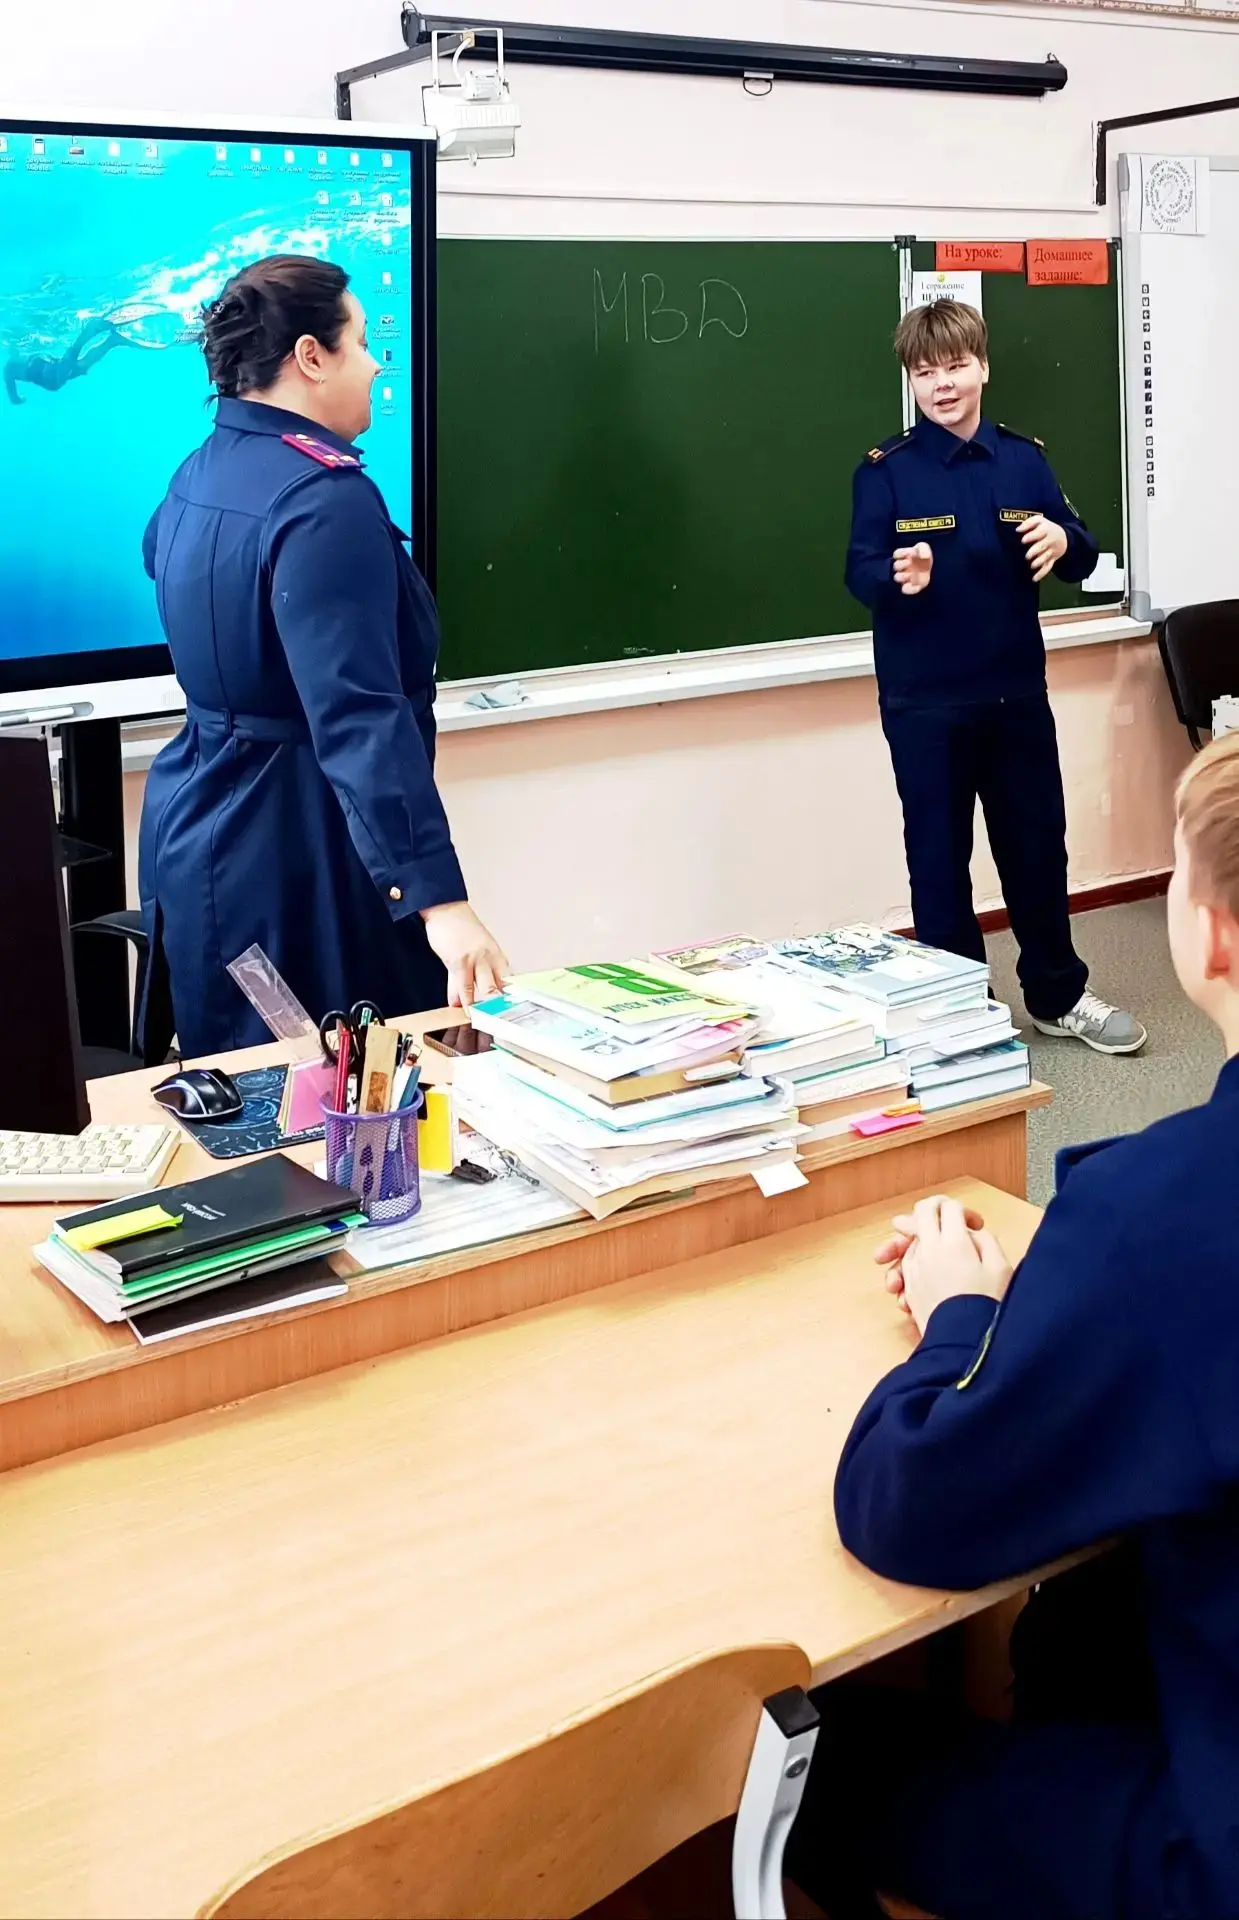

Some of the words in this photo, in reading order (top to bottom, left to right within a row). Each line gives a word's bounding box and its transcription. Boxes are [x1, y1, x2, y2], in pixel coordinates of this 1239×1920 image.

[944, 244, 962, 258] На
[964, 247, 1003, 262] уроке:
[1034, 248, 1093, 263] Домашнее
[1034, 270, 1083, 281] задание:
